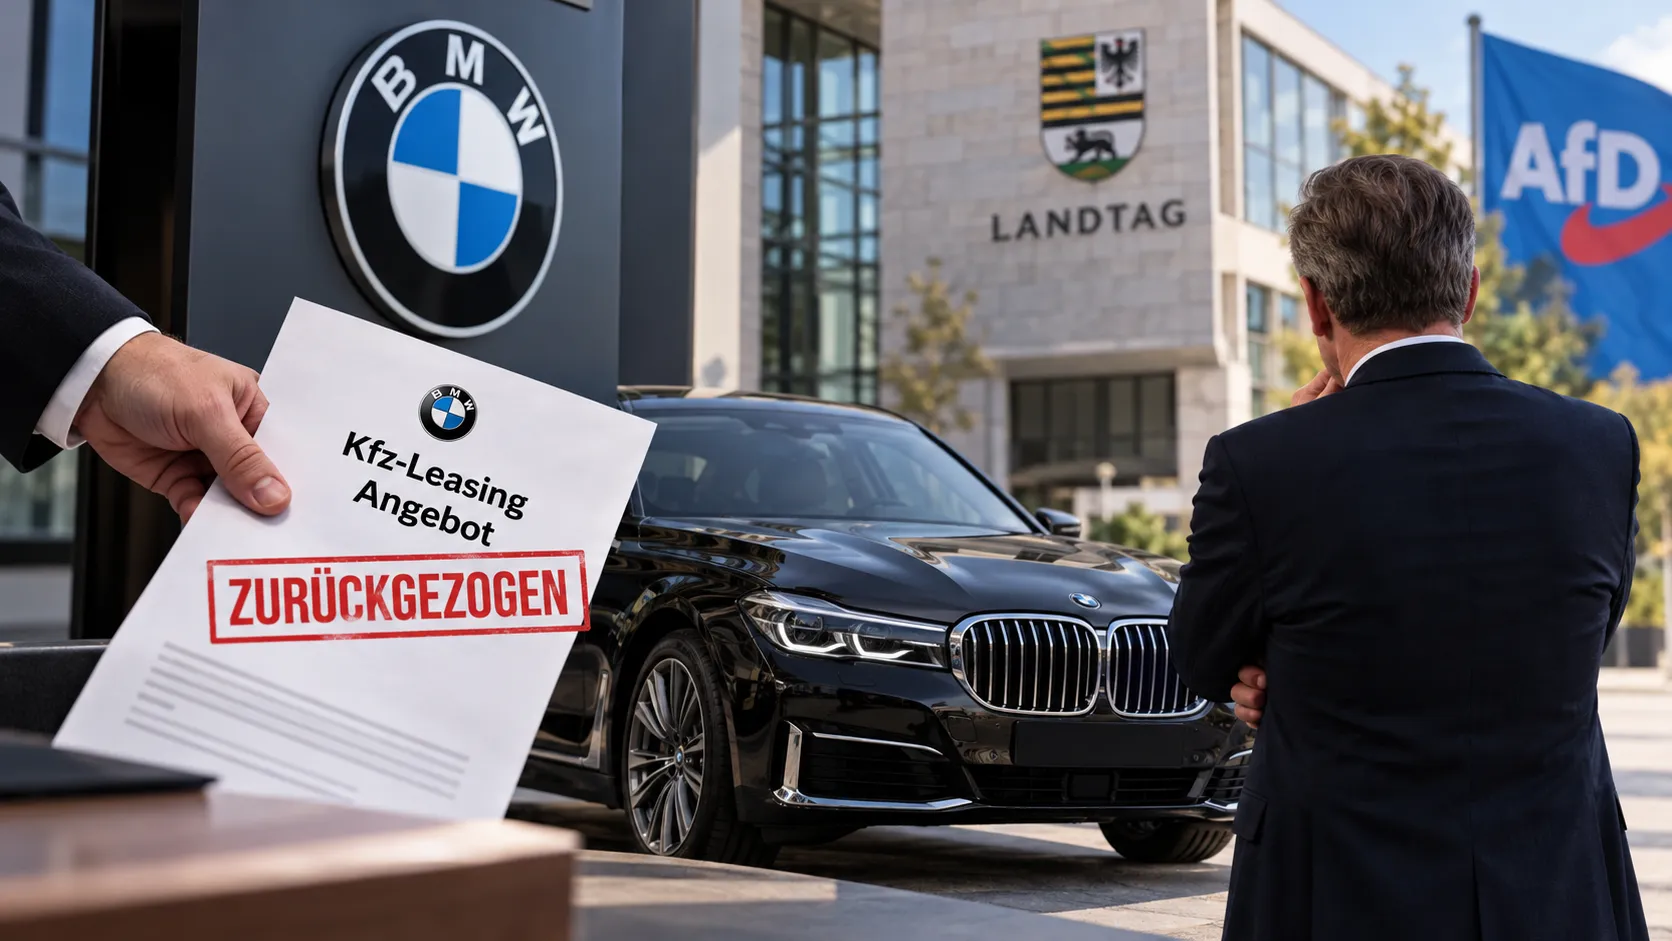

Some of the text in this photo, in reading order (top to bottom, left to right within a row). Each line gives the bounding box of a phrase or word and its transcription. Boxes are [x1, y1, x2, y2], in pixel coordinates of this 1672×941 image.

[371, 34, 546, 146] BMW
[1500, 119, 1661, 210] AfD
[991, 199, 1187, 242] LANDTAG
[431, 387, 475, 411] BMW
[342, 431, 529, 520] Kfz-Leasing
[353, 480, 495, 546] Angebot
[228, 567, 569, 626] ZURÜCKGEZOGEN
